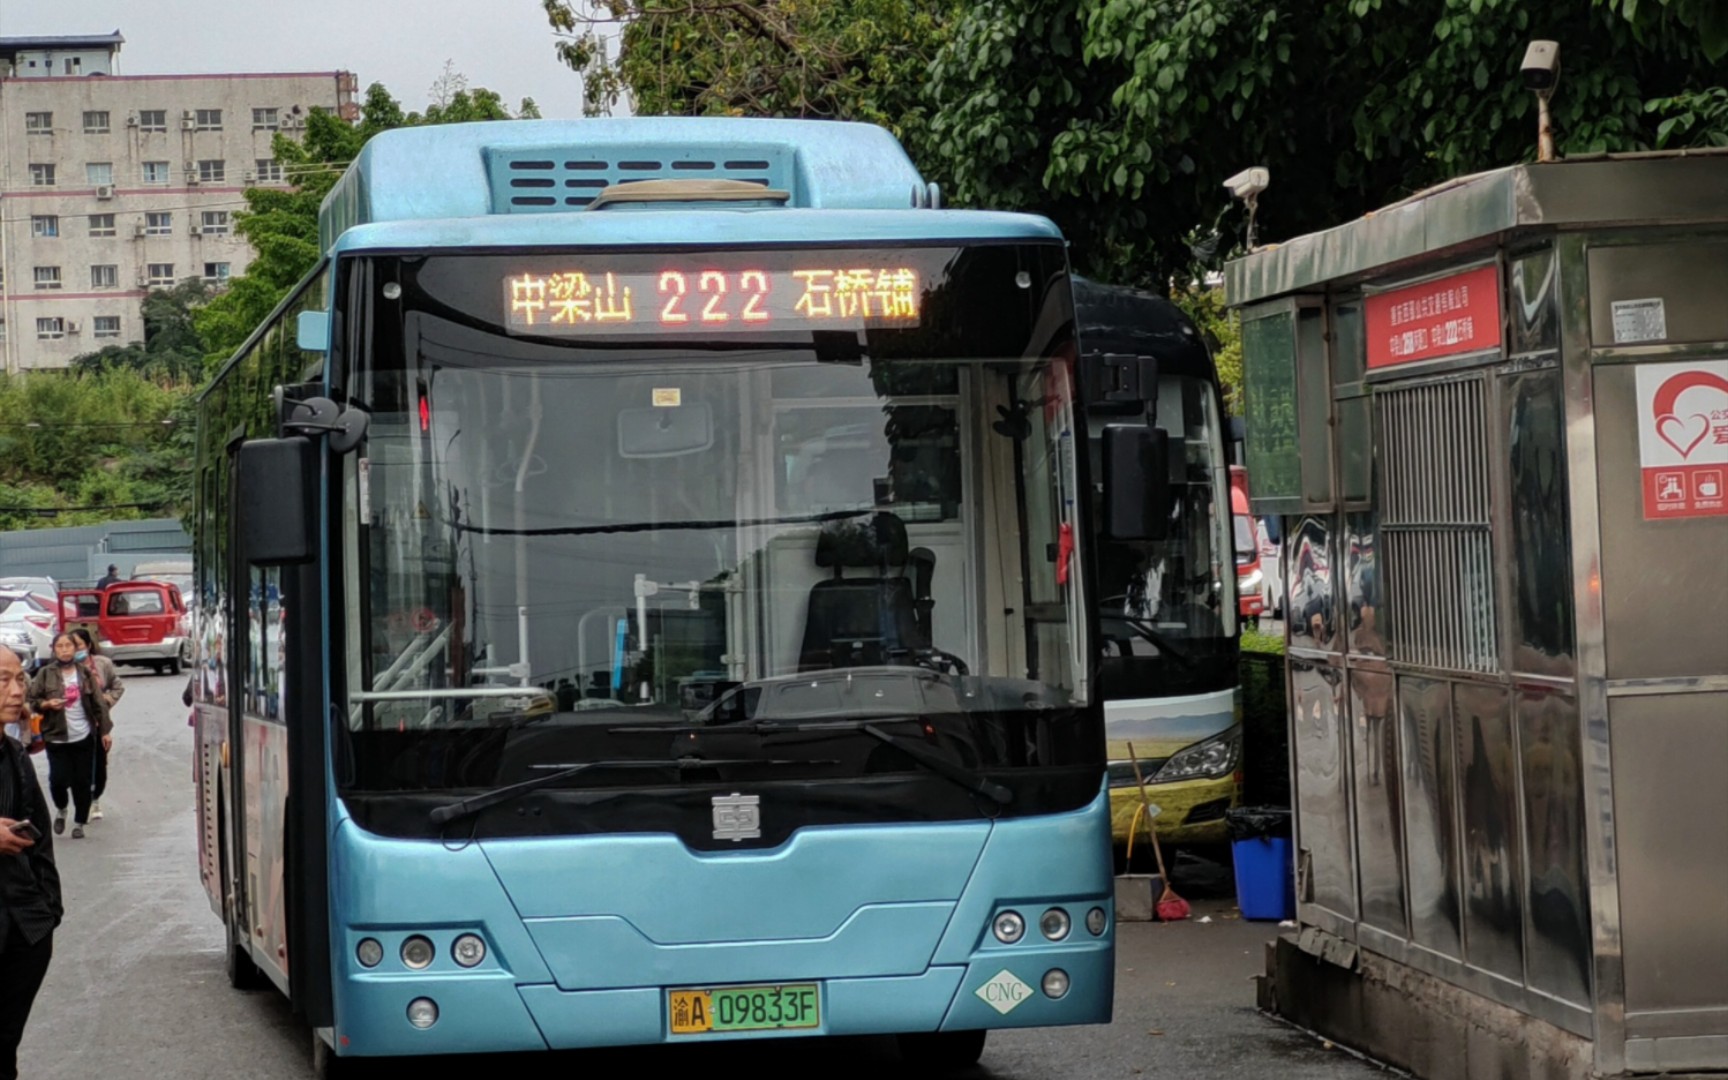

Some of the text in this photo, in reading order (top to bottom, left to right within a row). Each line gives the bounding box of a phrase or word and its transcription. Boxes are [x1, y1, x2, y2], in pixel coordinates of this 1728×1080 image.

[511, 269, 916, 325] 中梁山 222 石桥铺
[985, 982, 1023, 1001] CNG
